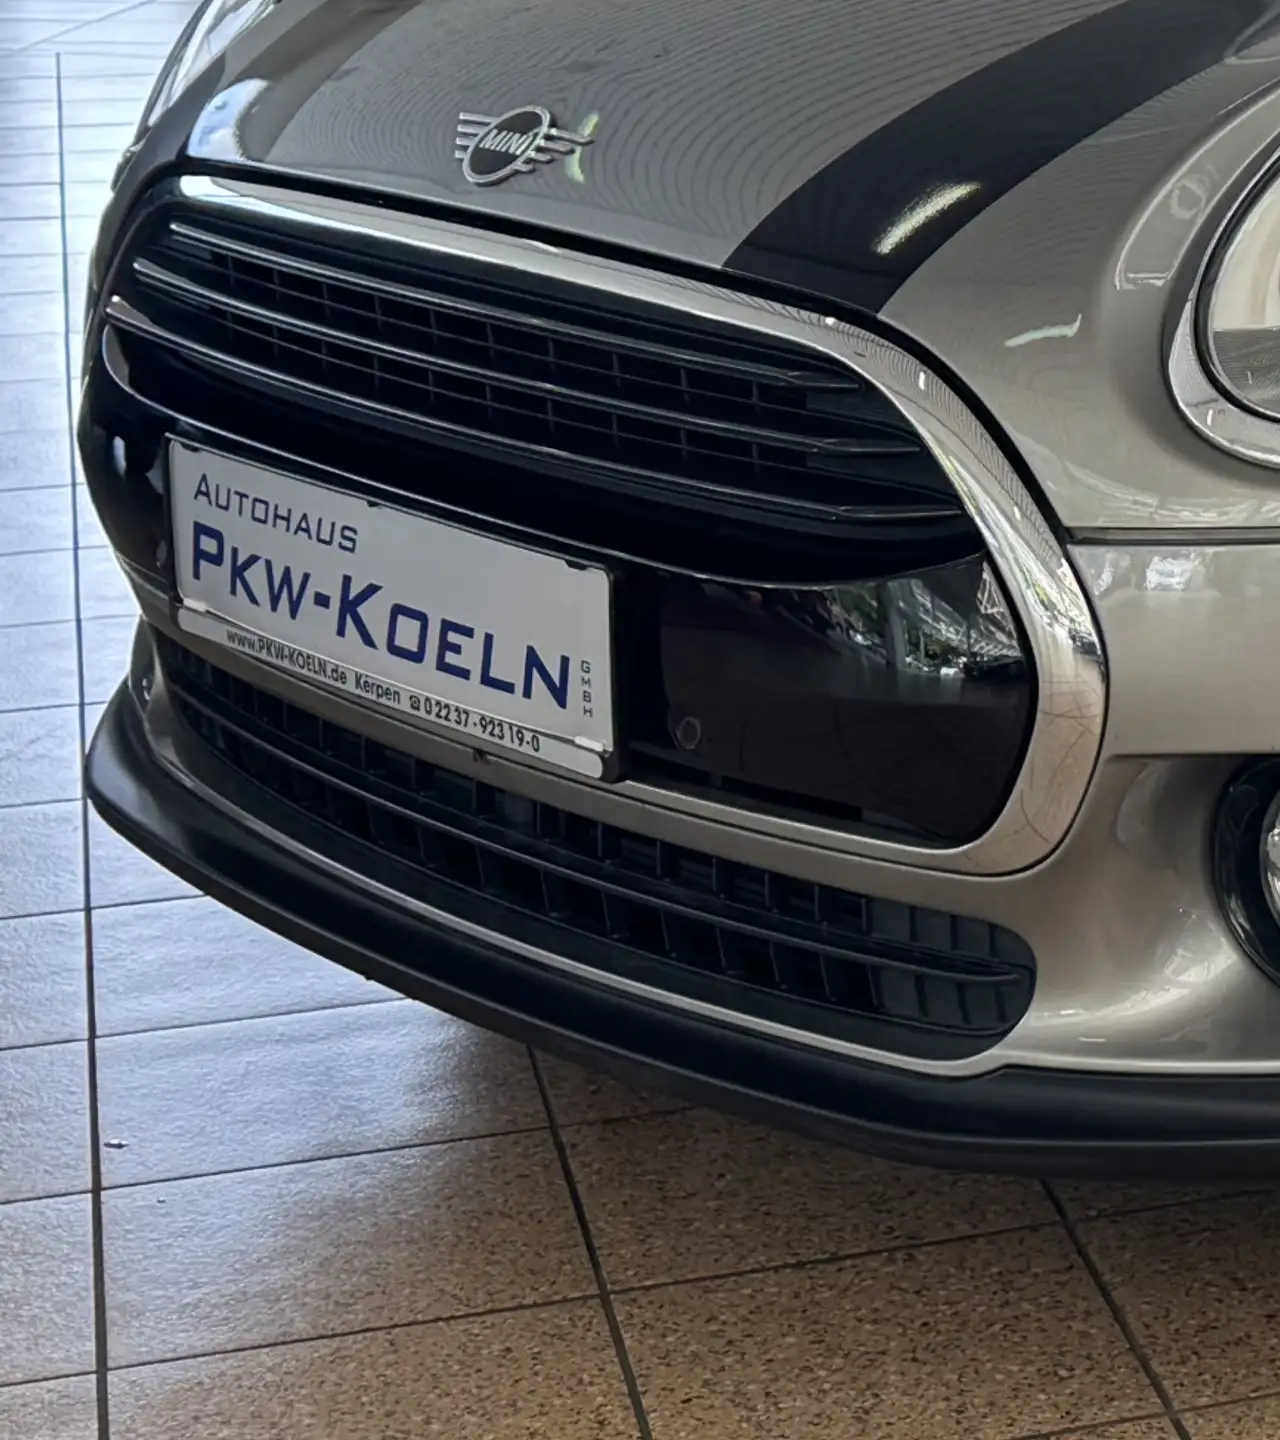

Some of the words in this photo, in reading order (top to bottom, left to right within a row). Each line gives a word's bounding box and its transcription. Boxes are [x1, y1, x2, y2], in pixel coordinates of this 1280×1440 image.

[479, 128, 534, 156] MINI
[193, 472, 358, 554] AUTOHAUS
[192, 520, 571, 710] PKW-KOELN
[354, 670, 401, 705] Kerpen
